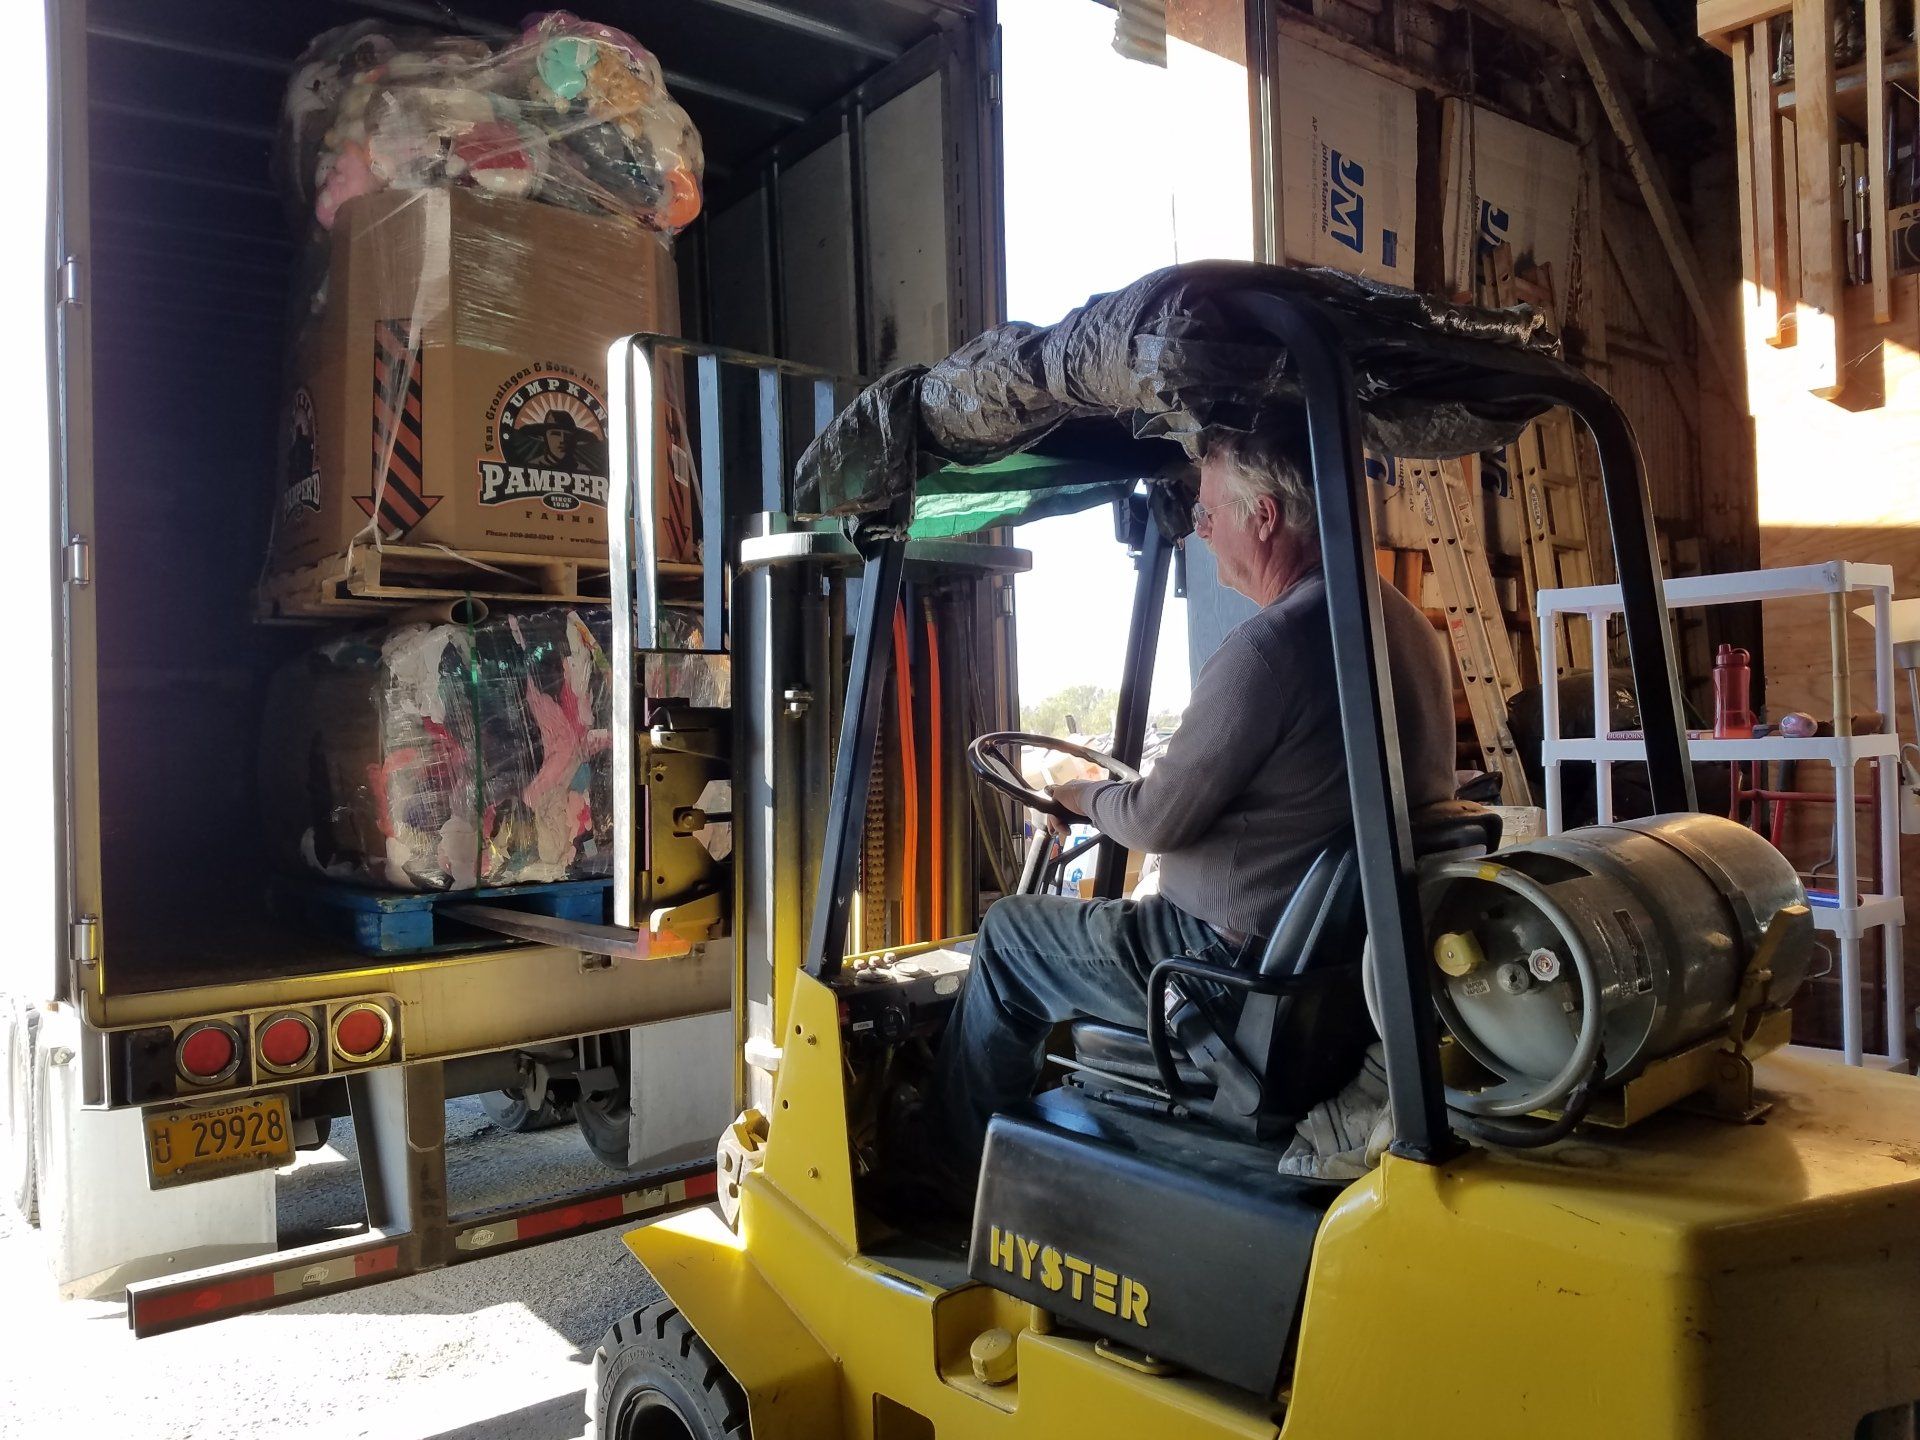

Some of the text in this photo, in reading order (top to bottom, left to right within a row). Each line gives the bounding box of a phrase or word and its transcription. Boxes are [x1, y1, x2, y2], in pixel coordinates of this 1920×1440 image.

[1321, 180, 1329, 234] Manville
[1331, 149, 1364, 254] JM
[485, 367, 531, 420] Groningen
[484, 425, 495, 452] Van
[482, 463, 608, 502] PAMPER
[525, 510, 594, 524] FARMS
[189, 1105, 244, 1121] OREGON
[191, 1108, 283, 1158] 29928
[989, 1225, 1149, 1328] HYSTER
